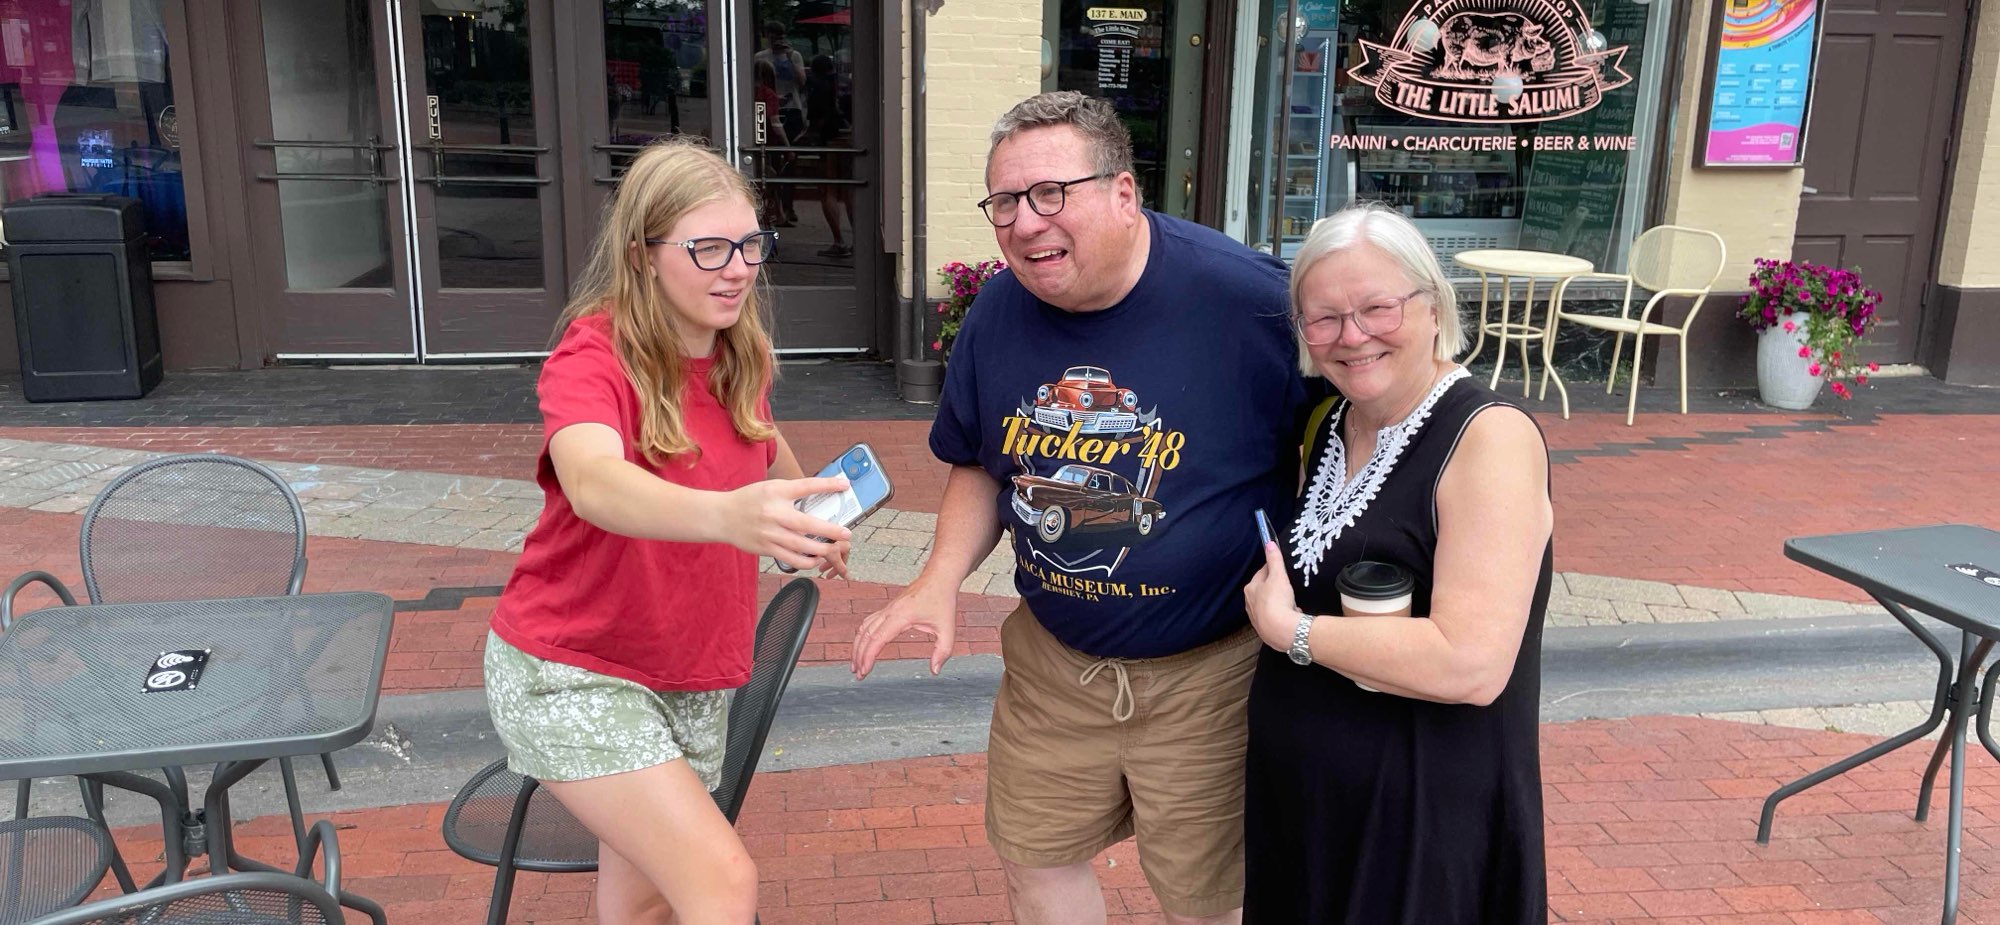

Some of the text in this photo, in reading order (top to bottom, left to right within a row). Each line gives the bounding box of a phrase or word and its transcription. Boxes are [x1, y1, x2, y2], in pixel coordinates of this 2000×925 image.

[1091, 9, 1144, 19] 137 E. MAIN
[1395, 82, 1433, 111] THE
[1438, 90, 1499, 117] LITTLE
[1507, 85, 1580, 116] SALUMI
[429, 98, 438, 136] PULL
[757, 104, 765, 141] PULL
[1330, 134, 1637, 151] PANINI CHARCUTERIE BEER & WINE
[1002, 416, 1185, 470] Tucker '48
[1050, 571, 1134, 599] MUSEUM,
[1140, 583, 1177, 597] Inc.
[1086, 593, 1100, 602] PA
